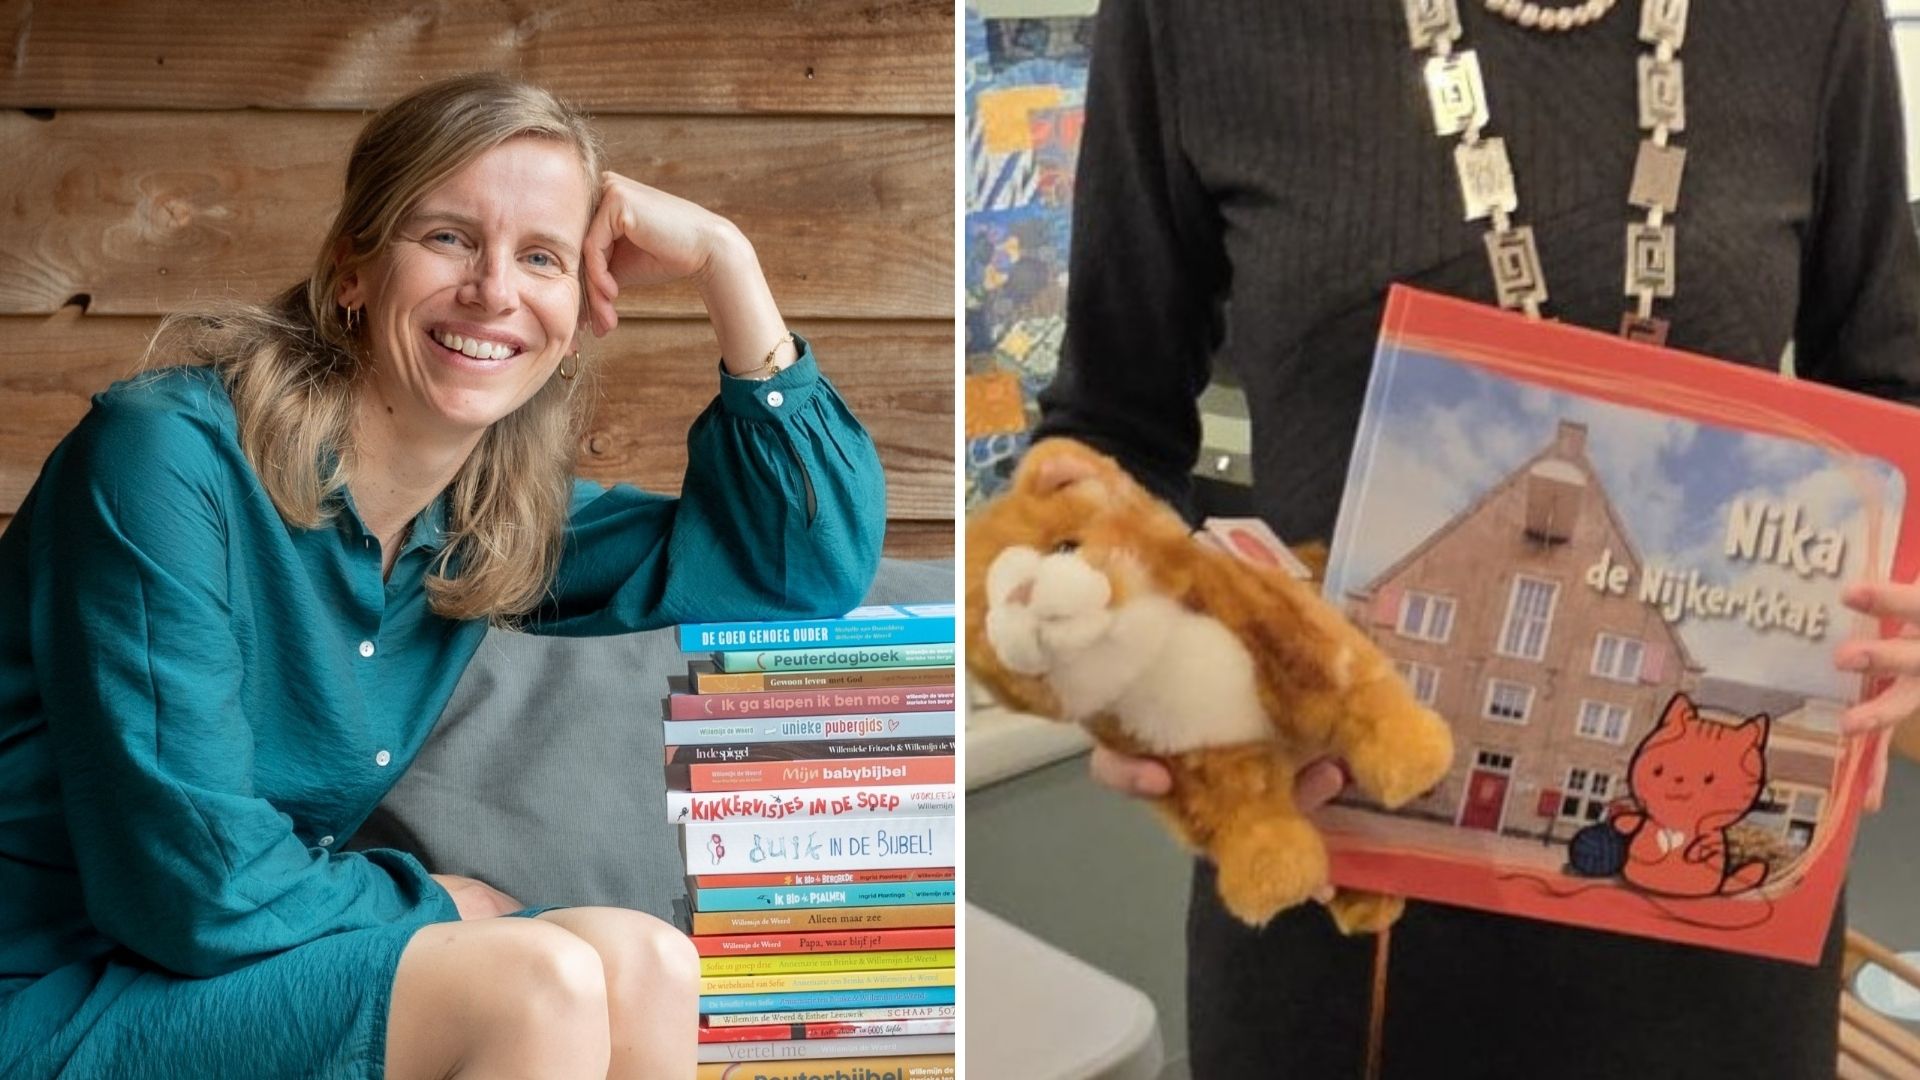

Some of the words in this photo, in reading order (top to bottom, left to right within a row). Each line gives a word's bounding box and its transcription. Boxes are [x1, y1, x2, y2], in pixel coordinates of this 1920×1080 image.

[1725, 498, 1845, 578] Nika
[1586, 549, 1629, 594] de
[1639, 564, 1827, 638] Nijkerkkat
[702, 632, 715, 645] DE
[719, 631, 746, 645] GOED
[750, 629, 790, 643] GENOEG
[793, 627, 828, 641] OUDER
[774, 650, 899, 666] Peuterdagboek
[722, 699, 735, 711] Ik
[740, 701, 759, 712] ga
[764, 698, 813, 711] slapen
[818, 695, 831, 707] ik
[835, 695, 863, 706] ben
[868, 694, 899, 705] moe
[782, 722, 821, 735] unieke
[826, 719, 882, 737] pubergids
[869, 744, 895, 752] Fritzsch
[904, 743, 938, 751] Willemijn
[783, 768, 818, 782] Mijn
[823, 766, 906, 781] babybijbel
[691, 795, 803, 821] KIKKERVISJES
[809, 798, 826, 816] IN
[832, 796, 853, 815] DE
[857, 792, 899, 811] SOEP
[830, 838, 841, 856] IN
[850, 836, 870, 855] DE
[810, 891, 845, 904] PSALMEN
[732, 919, 760, 927] Willemijn
[808, 915, 837, 924] Alleen
[722, 942, 751, 950] Willemijn
[800, 938, 823, 950] Papa,
[850, 936, 867, 948] blijf
[723, 1015, 759, 1023] Willemijn
[772, 1013, 796, 1021] Weerd
[806, 1012, 829, 1020] Esther
[888, 1008, 932, 1017] SCHAAP
[727, 1043, 775, 1059] Vertel
[781, 1045, 806, 1056] me
